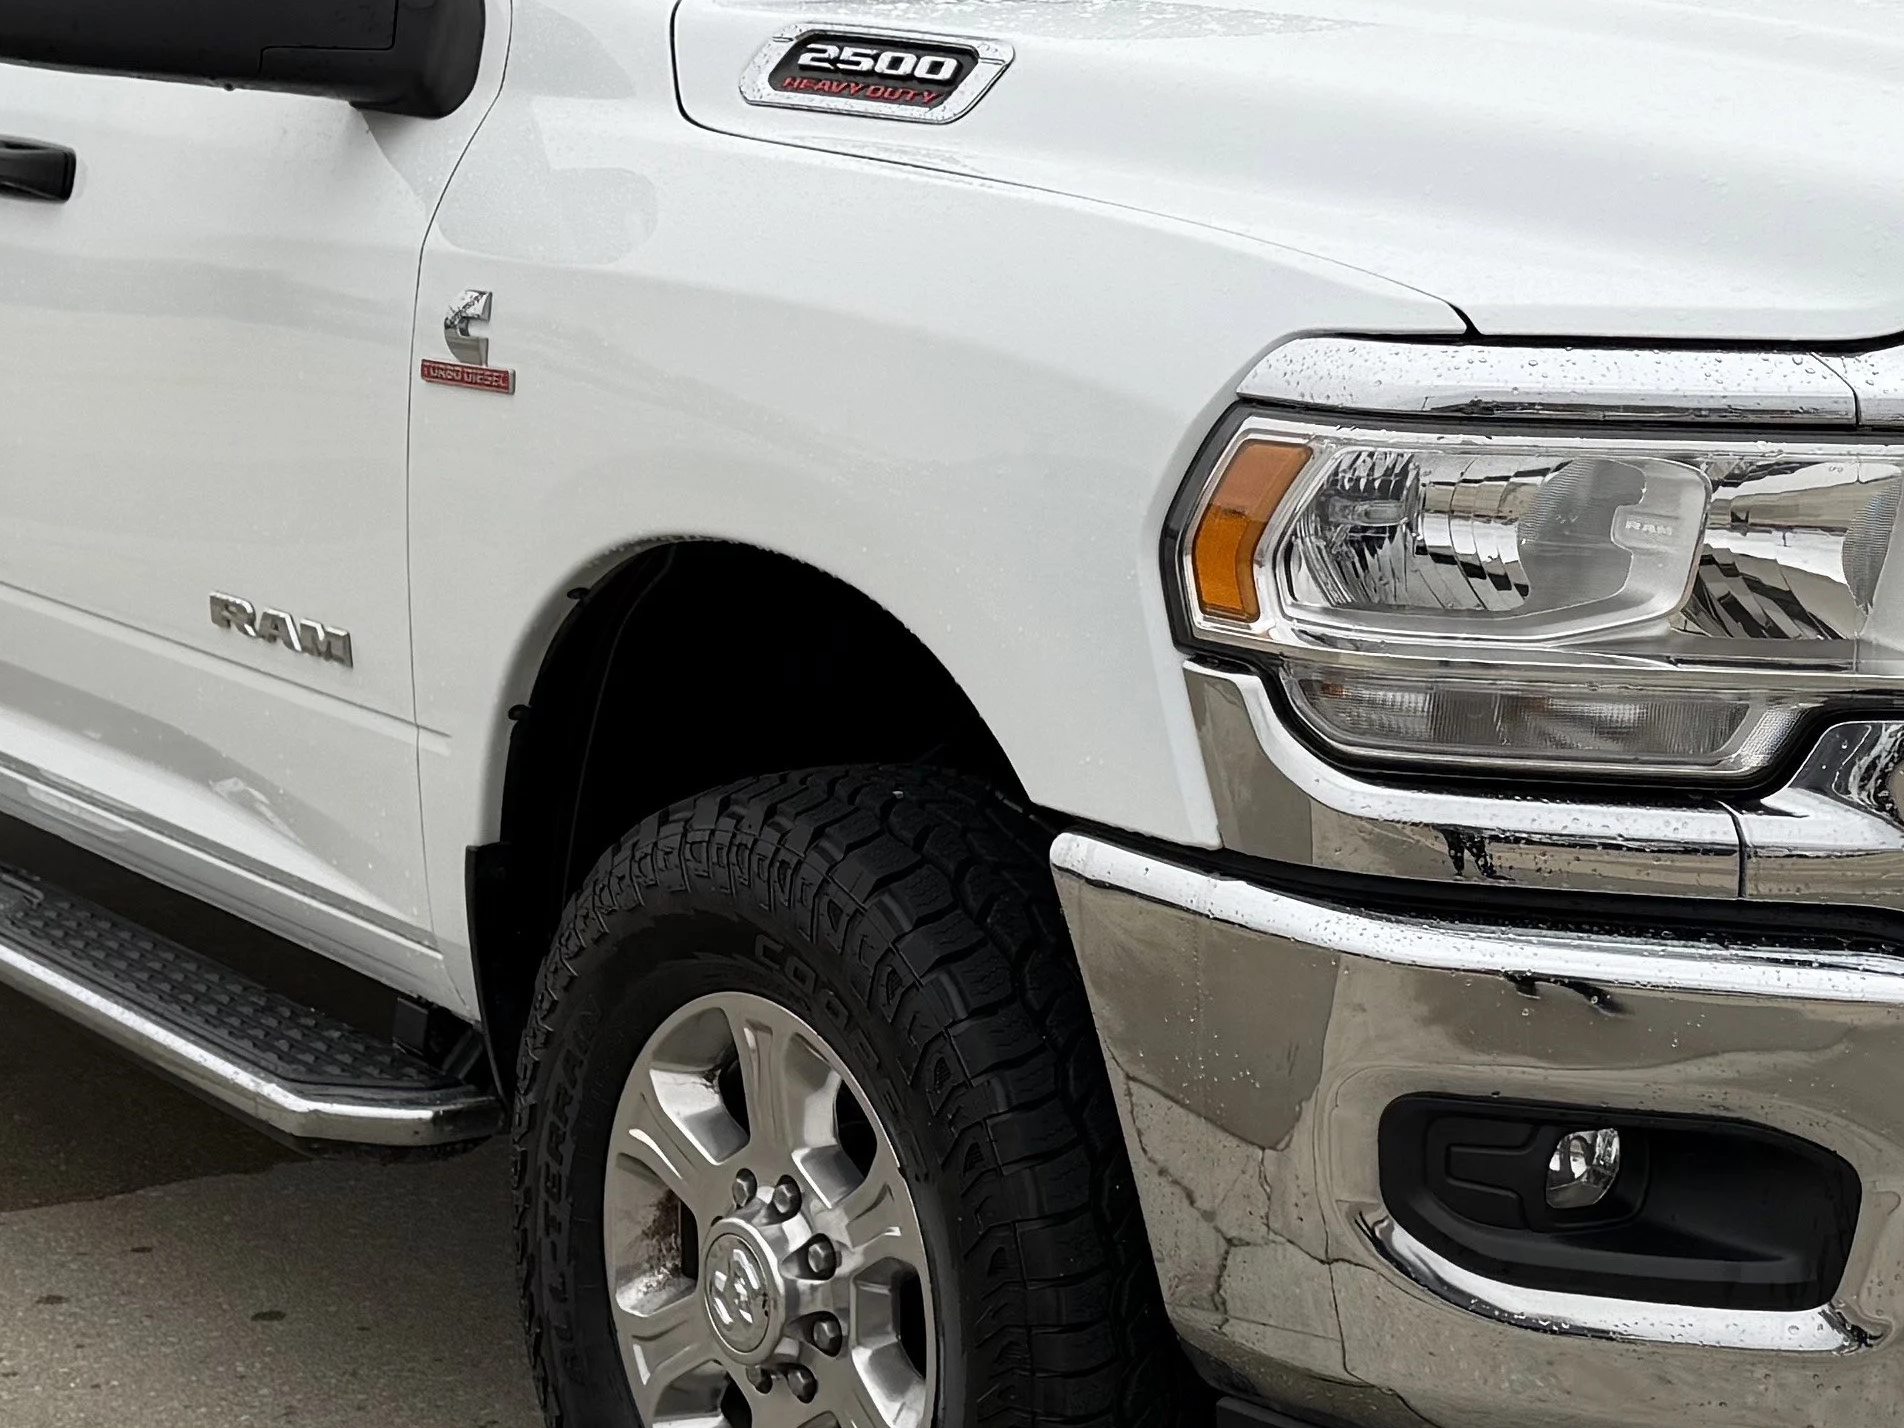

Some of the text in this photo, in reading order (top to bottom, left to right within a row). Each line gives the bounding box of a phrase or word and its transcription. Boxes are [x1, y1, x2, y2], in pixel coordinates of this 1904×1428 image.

[797, 43, 959, 81] 2500
[782, 76, 944, 105] HEAVY DUTY
[209, 591, 354, 669] RAM
